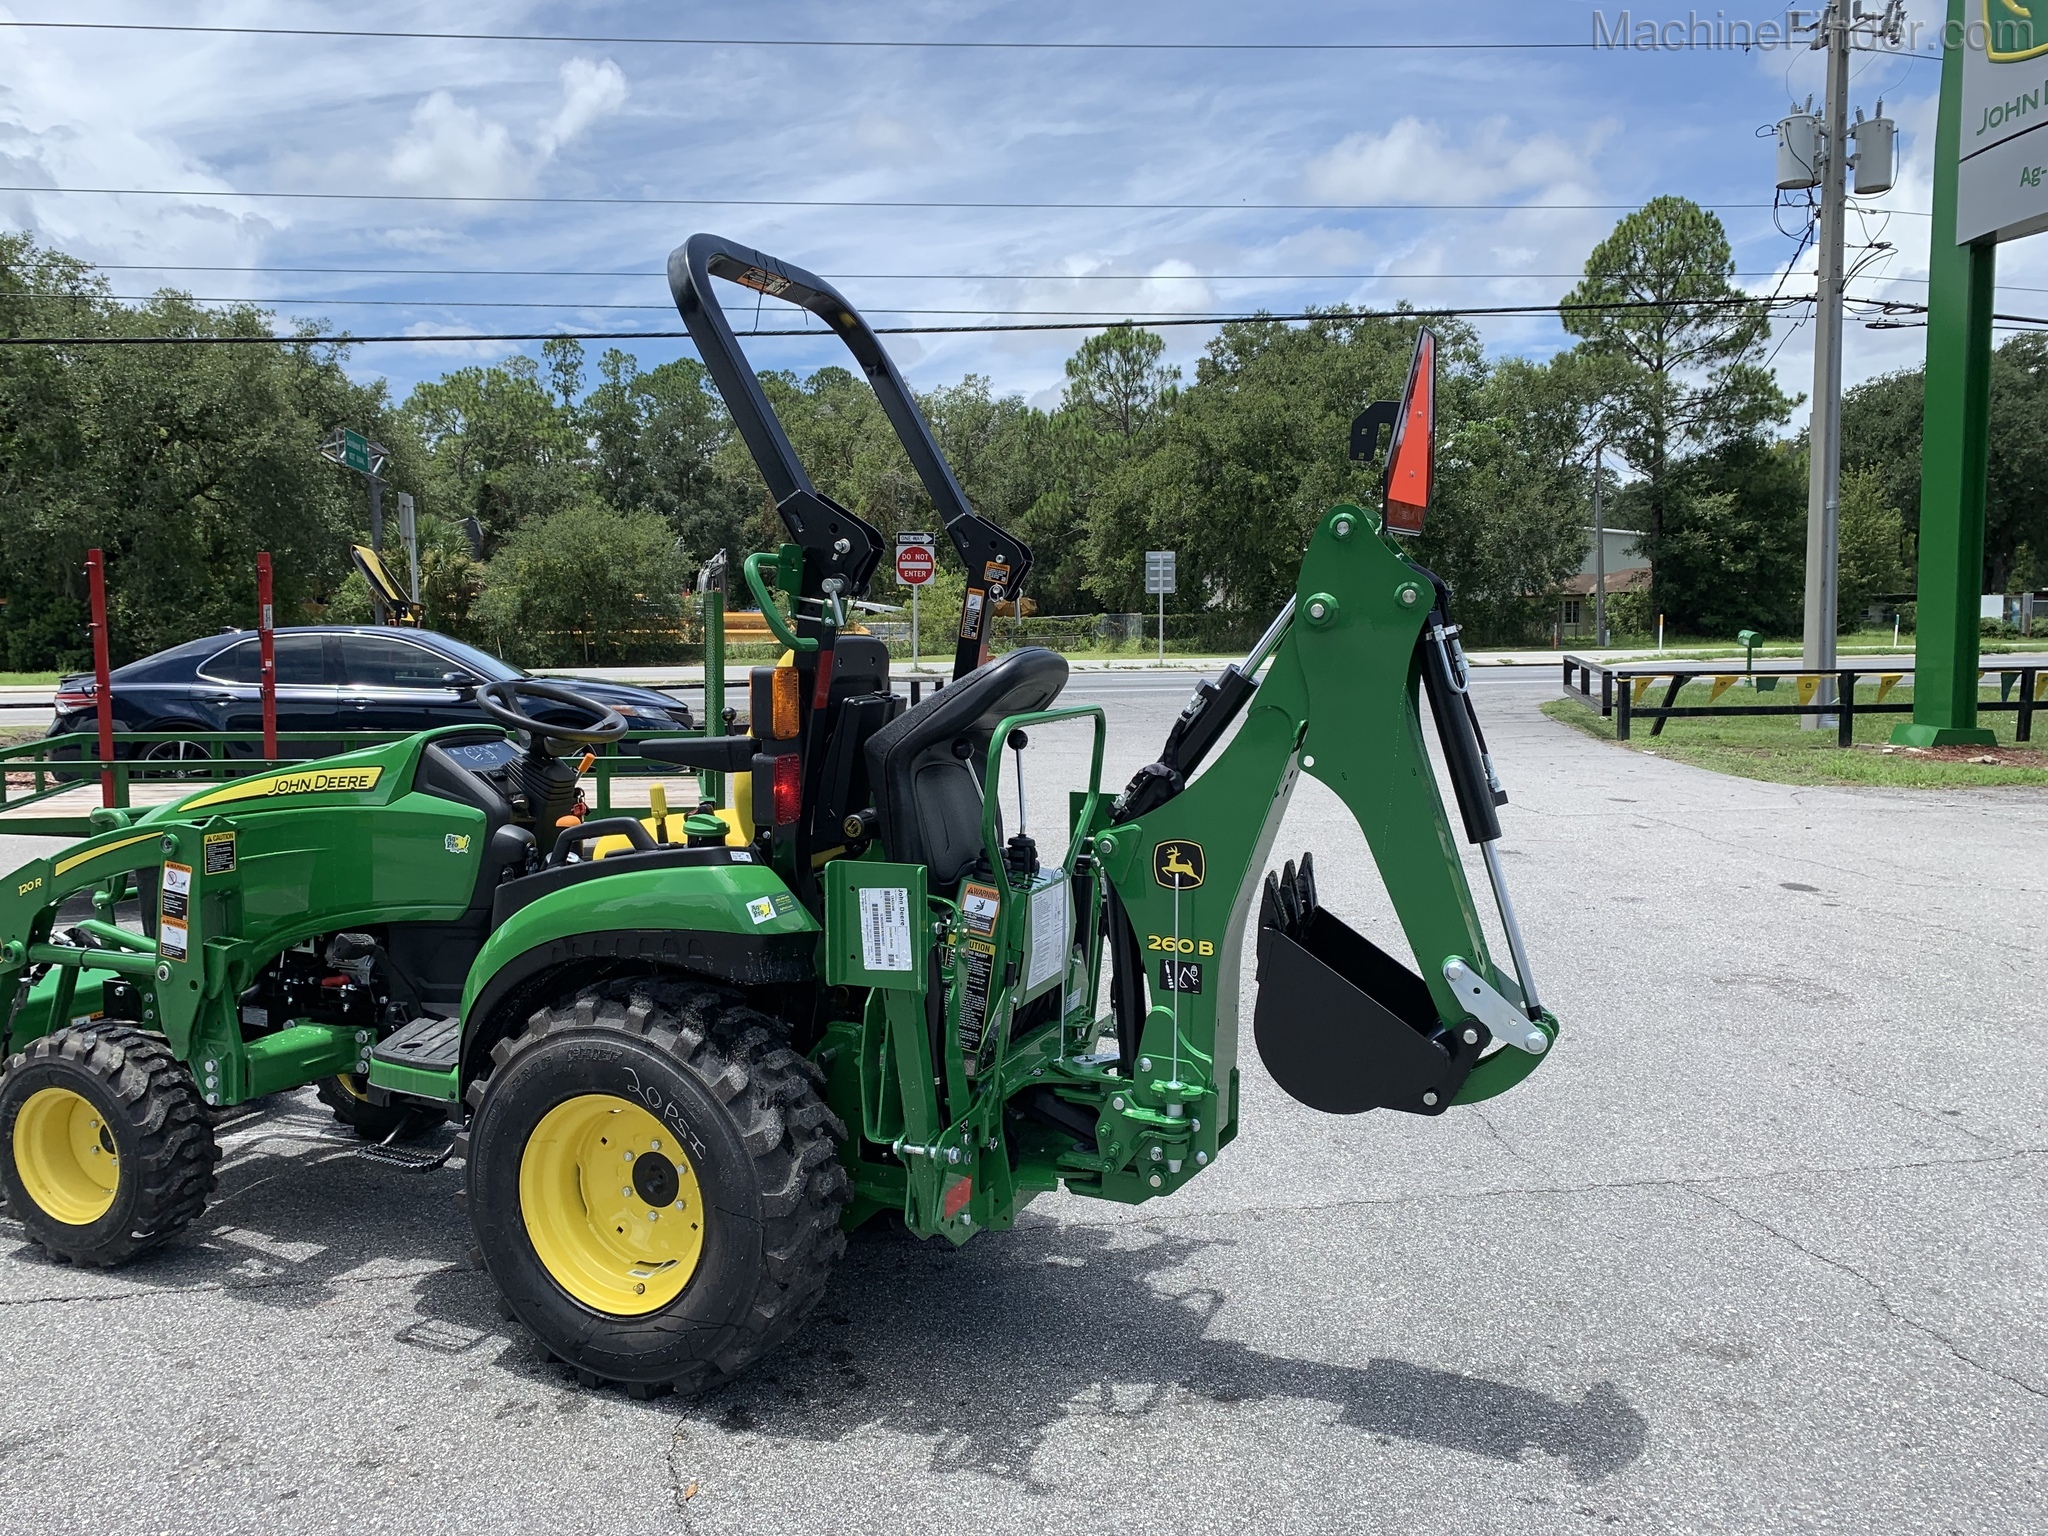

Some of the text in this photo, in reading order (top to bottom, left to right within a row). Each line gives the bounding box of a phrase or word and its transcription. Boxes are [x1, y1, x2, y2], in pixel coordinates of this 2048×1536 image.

[1976, 88, 2039, 136] JOHN
[901, 553, 929, 561] DO NOT
[904, 570, 927, 578] ENTER
[268, 775, 370, 794] JOHN DEERE
[212, 832, 234, 842] CAUTION
[974, 887, 1000, 901] WARNING
